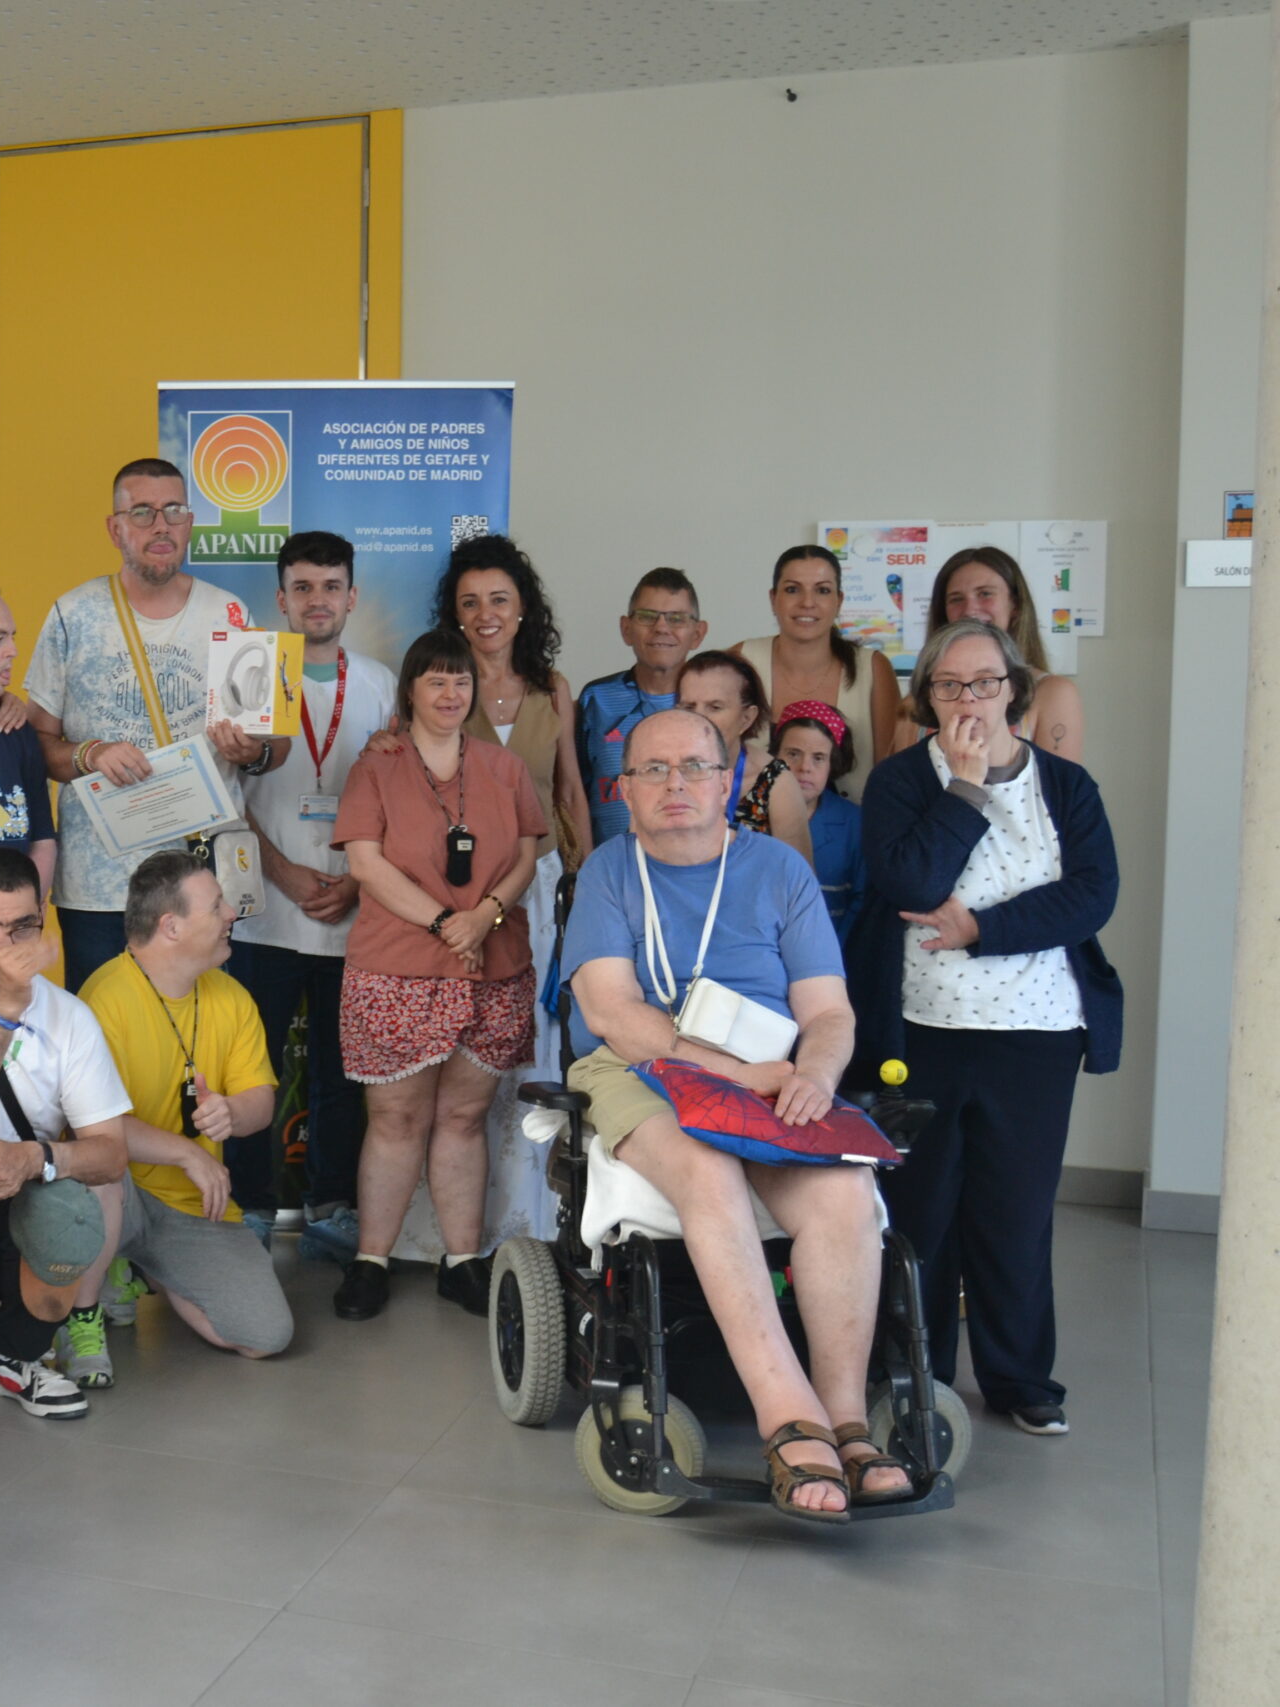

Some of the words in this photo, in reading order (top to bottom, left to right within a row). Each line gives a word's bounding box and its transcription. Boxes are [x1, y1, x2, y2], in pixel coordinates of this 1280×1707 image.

[322, 420, 406, 434] ASOCIACIÓN
[409, 423, 428, 434] DE
[431, 423, 486, 434] PADRES
[338, 438, 347, 450] Y
[350, 438, 403, 450] AMIGOS
[406, 438, 425, 450] DE
[428, 436, 470, 450] NIÑOS
[317, 454, 400, 465] DIFERENTES
[403, 454, 422, 465] DE
[424, 454, 478, 465] GETAFE
[481, 454, 490, 465] Y
[324, 469, 405, 481] COMUNIDAD
[408, 469, 427, 481] DE
[430, 469, 483, 481] MADRID
[355, 526, 433, 536] www.apanid.es
[193, 533, 286, 554] APANID
[353, 542, 434, 553] anid@apanid.es
[886, 553, 926, 565] SEUR
[1214, 566, 1241, 576] SALÓN
[143, 643, 193, 662] ORIGINAL
[166, 658, 204, 682] LONDON
[156, 672, 195, 715] SOUL
